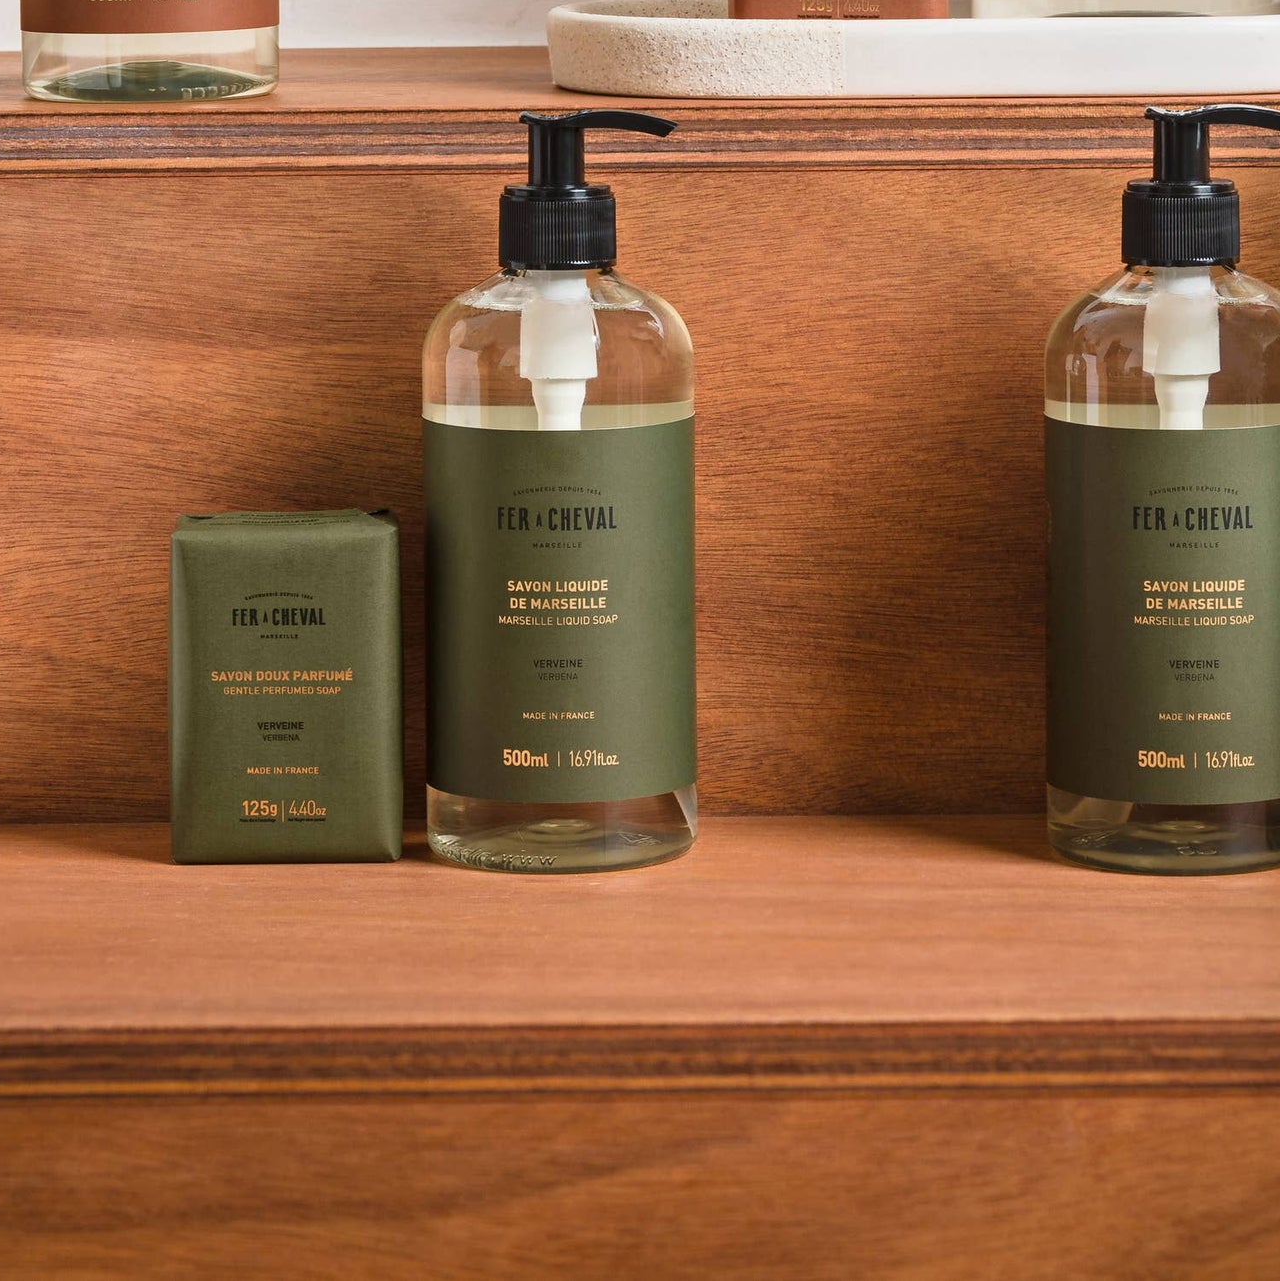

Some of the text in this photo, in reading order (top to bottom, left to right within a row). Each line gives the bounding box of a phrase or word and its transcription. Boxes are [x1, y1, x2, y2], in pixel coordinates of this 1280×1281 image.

[497, 506, 530, 531] FER
[548, 505, 618, 532] CHEVAL
[1133, 506, 1167, 531] FER
[1185, 505, 1254, 531] CHEVAL
[532, 541, 583, 549] MARSEILLE
[1169, 541, 1220, 549] MARSEILLE
[507, 579, 609, 593] SAVON LIQUIDE
[1143, 579, 1246, 593] SAVON LIQUIDE
[509, 596, 607, 610] DE MARSEILLE
[1145, 596, 1243, 610] DE MARSEILLE
[231, 608, 260, 627] FER
[271, 607, 327, 627] CHEVAL
[498, 614, 619, 626] MARSEILLE LIQUID SOAP
[1133, 614, 1255, 626] MARSEILLE LIQUID SOAP
[533, 658, 584, 669] VERVEINE
[1168, 659, 1220, 670] VERVEINE
[210, 667, 353, 682] SAVON DOUX PARFUMÉ
[538, 672, 579, 681] VERBENA
[1174, 673, 1215, 682] VERBENA
[223, 686, 342, 696] GENTLE PERFUMED SOAP
[522, 711, 595, 720] MADE IN FRANCE
[1158, 712, 1232, 721] MADE IN FRANCE
[256, 721, 305, 731] VERVEINE
[262, 733, 301, 742] VERBENA
[503, 748, 549, 768] 500ml
[1137, 750, 1185, 769] 500ml
[246, 766, 320, 775] MADE IN FRANCE
[242, 799, 327, 817] 125g 4.40oz
